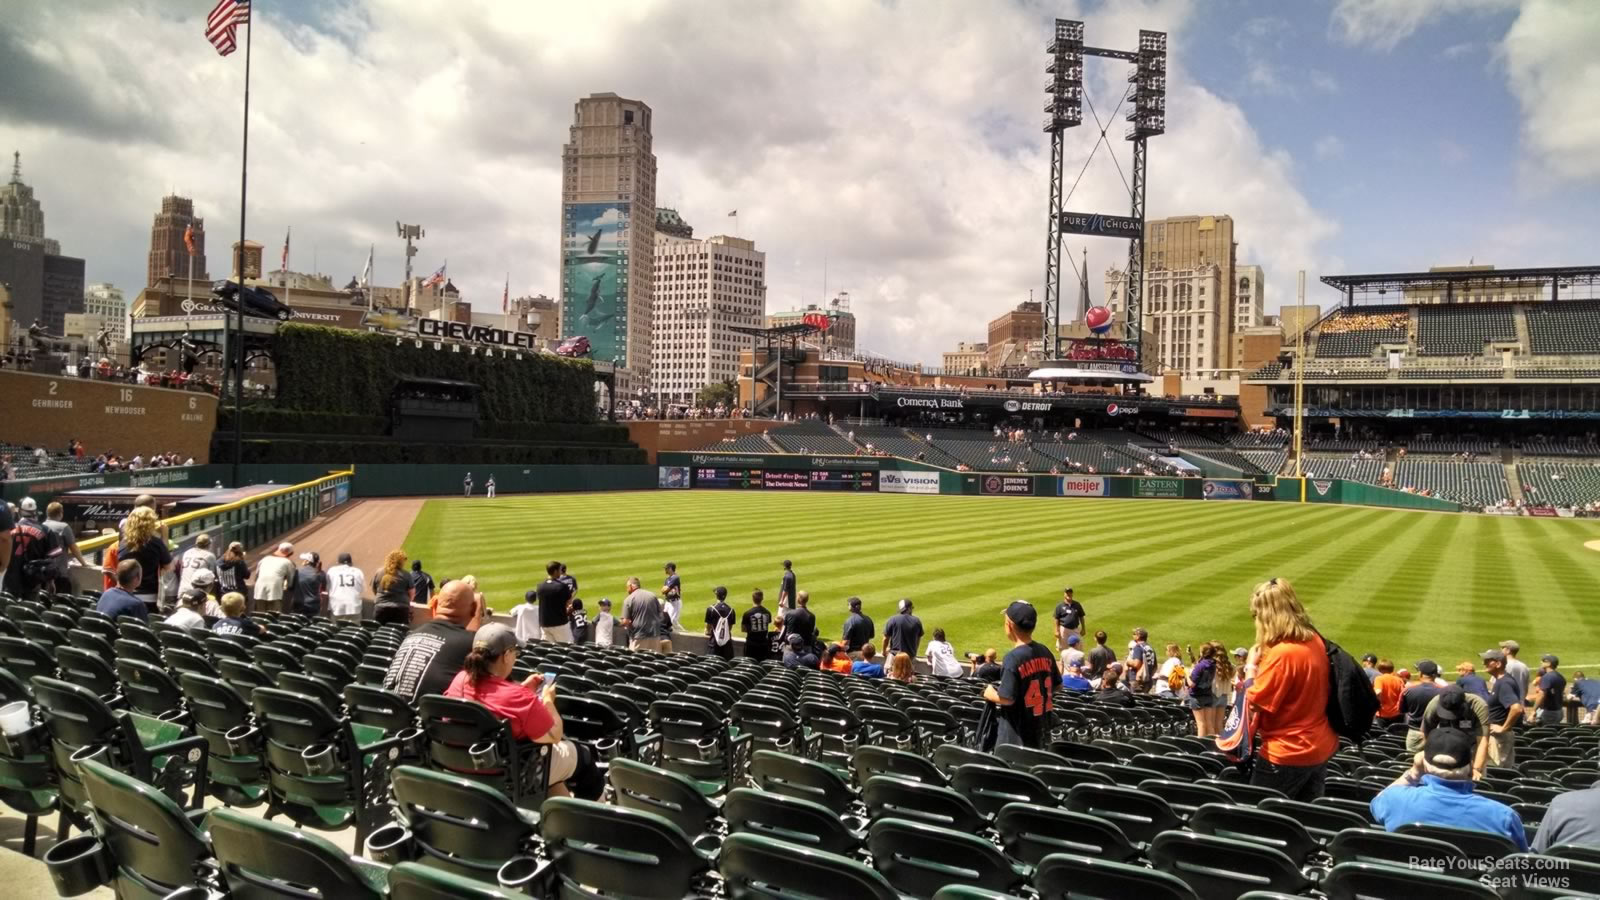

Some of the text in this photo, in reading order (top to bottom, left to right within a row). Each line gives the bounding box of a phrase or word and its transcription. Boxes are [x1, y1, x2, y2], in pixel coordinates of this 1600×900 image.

[1063, 213, 1142, 232] PURE MICHIGAN
[13, 241, 30, 250] 1001
[418, 317, 537, 349] CHEVROLET
[396, 337, 523, 361] FOUNTAIN
[1089, 363, 1120, 372] AMSTERDAM
[49, 381, 57, 395] 2
[120, 388, 133, 402] 16
[32, 399, 73, 409] GEHRINGER
[189, 397, 197, 410] 6
[940, 398, 964, 408] Bank
[1022, 402, 1053, 411] DETROIT
[1119, 403, 1139, 414] pepsi
[105, 405, 146, 416] NEWHOUSER
[181, 413, 204, 422] KALINE
[881, 474, 901, 484] SVS
[1139, 479, 1178, 488] EASTERN
[1066, 479, 1100, 493] meijer
[339, 574, 354, 587] 13
[1023, 675, 1054, 717] 41
